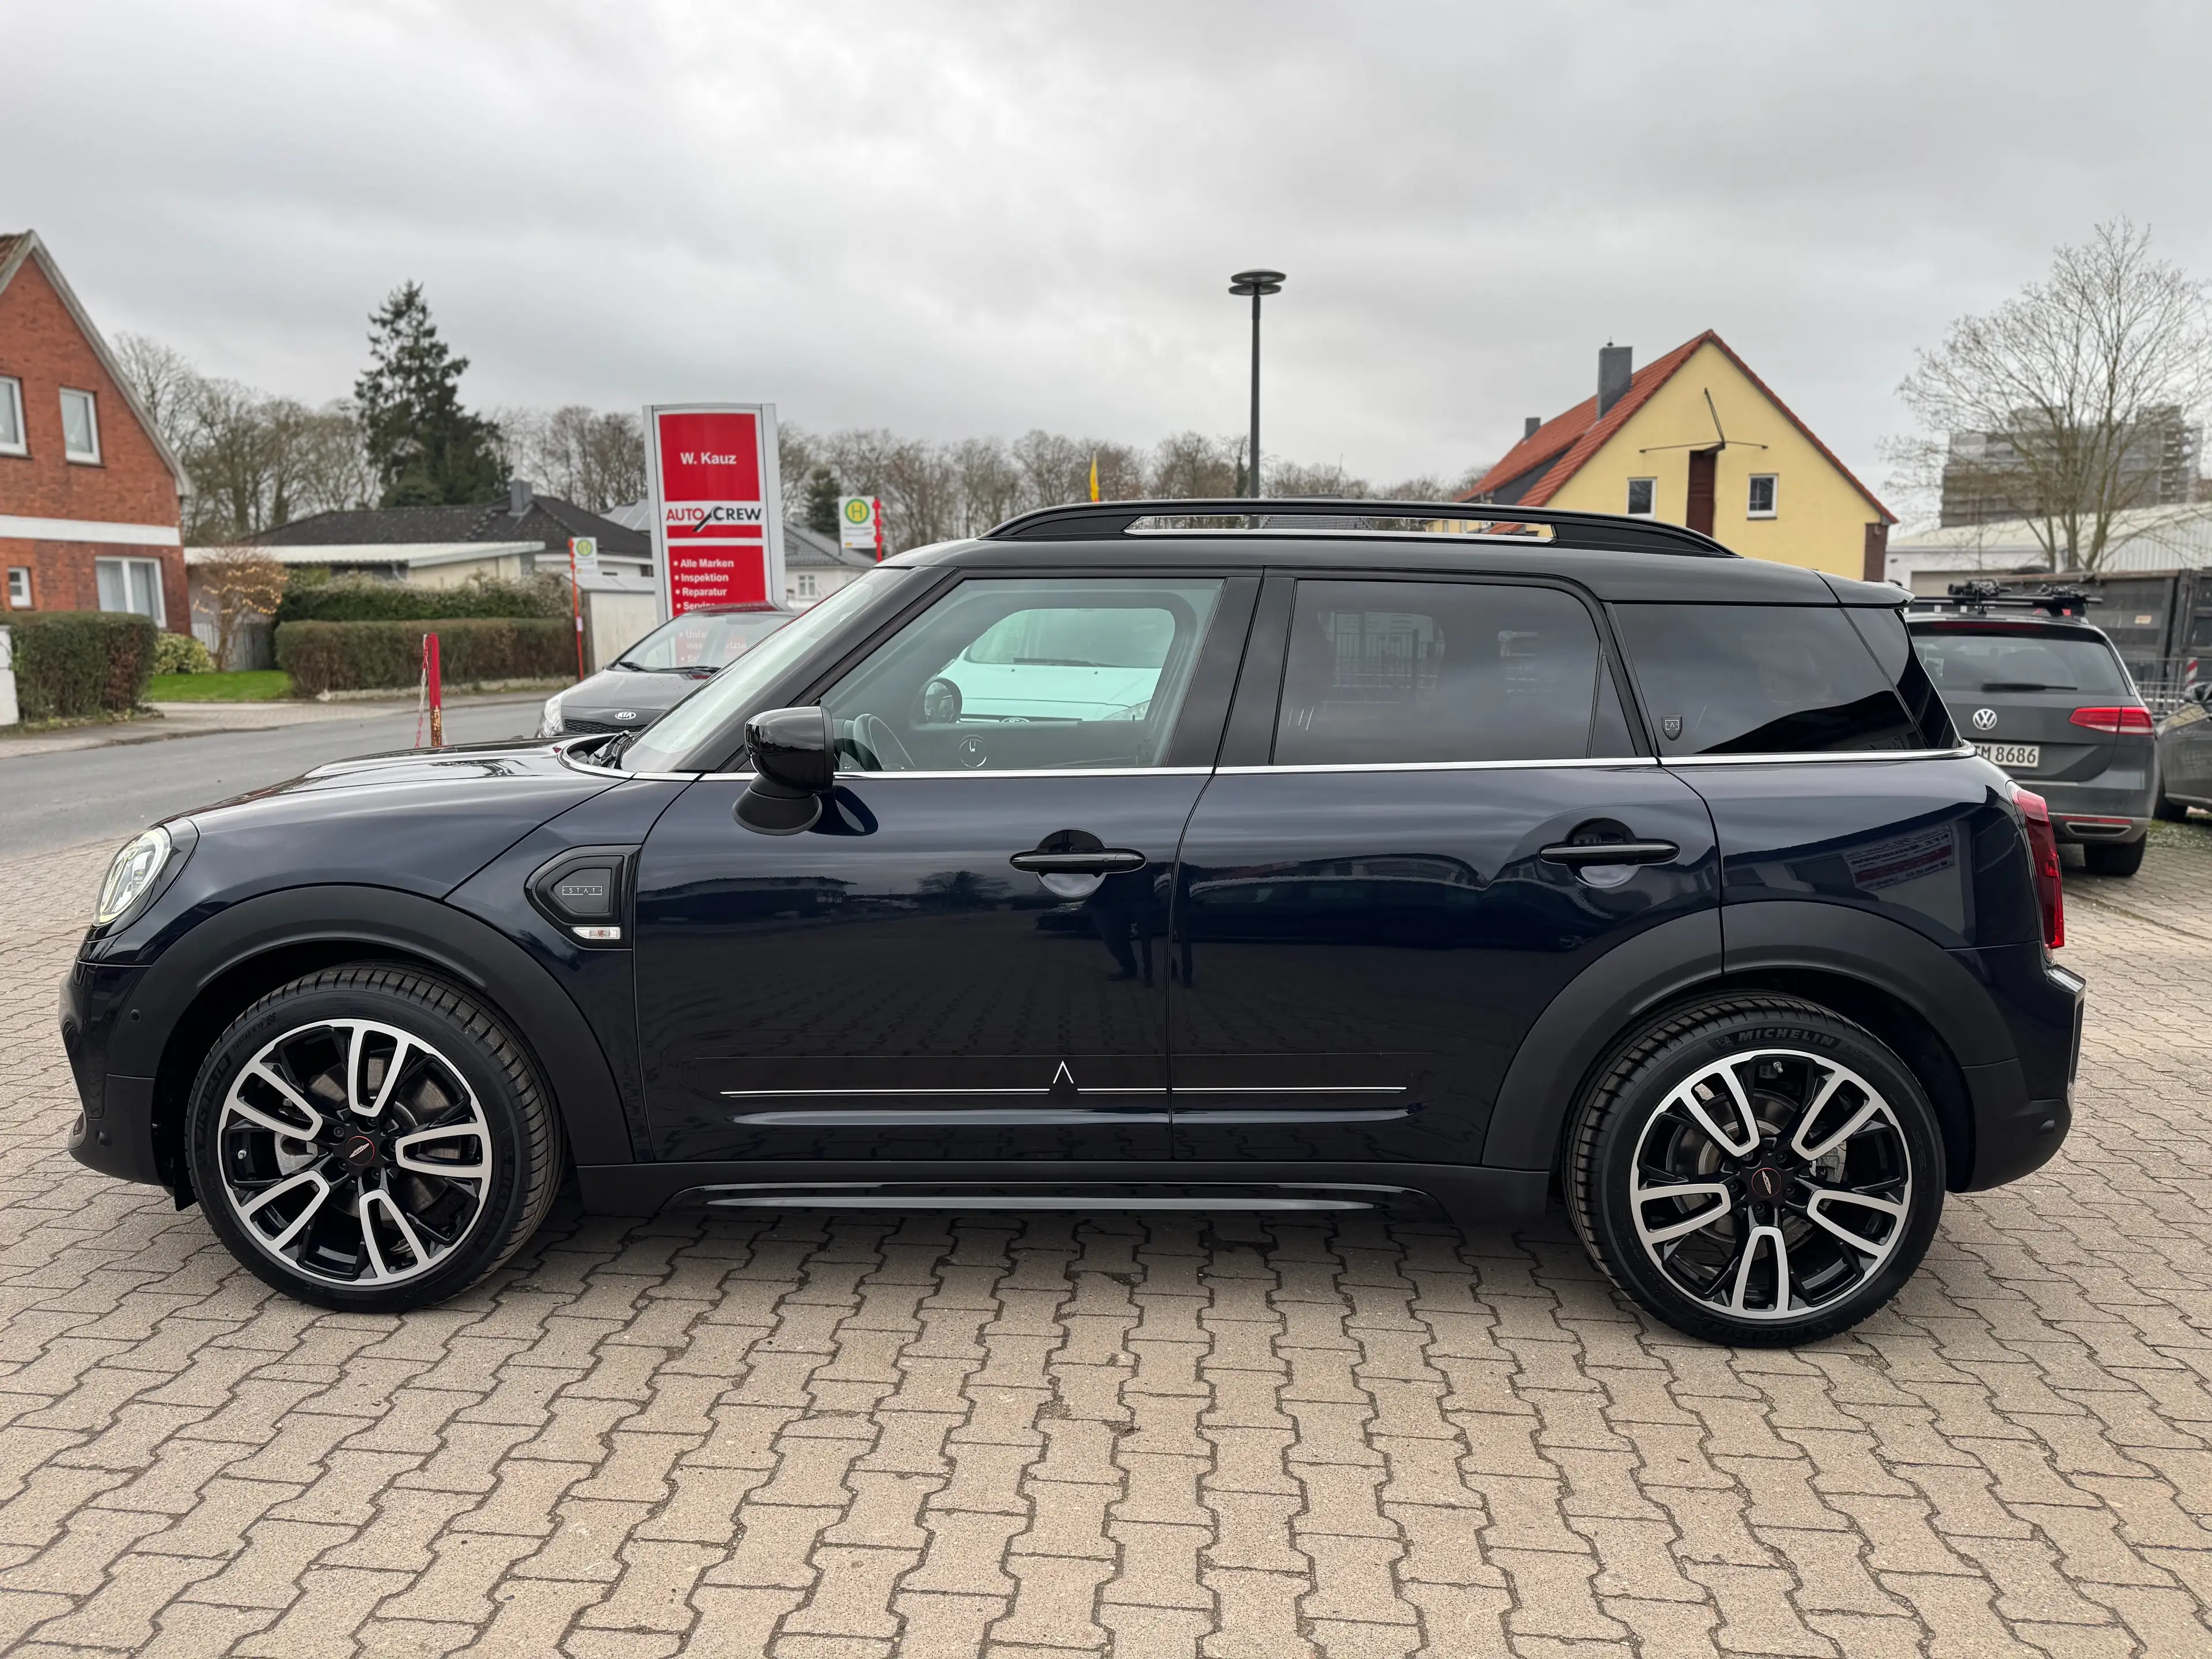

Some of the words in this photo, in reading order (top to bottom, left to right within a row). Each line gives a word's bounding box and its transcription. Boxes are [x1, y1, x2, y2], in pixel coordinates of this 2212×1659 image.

[680, 452, 697, 464] W.
[701, 452, 737, 464] Kauz
[680, 559, 697, 567] Alle
[699, 559, 734, 567] Marken
[681, 574, 729, 584] Inspektion
[683, 588, 727, 597] Reparatur
[1995, 747, 2036, 763] 8686
[1738, 1028, 1834, 1047] MICHELIN
